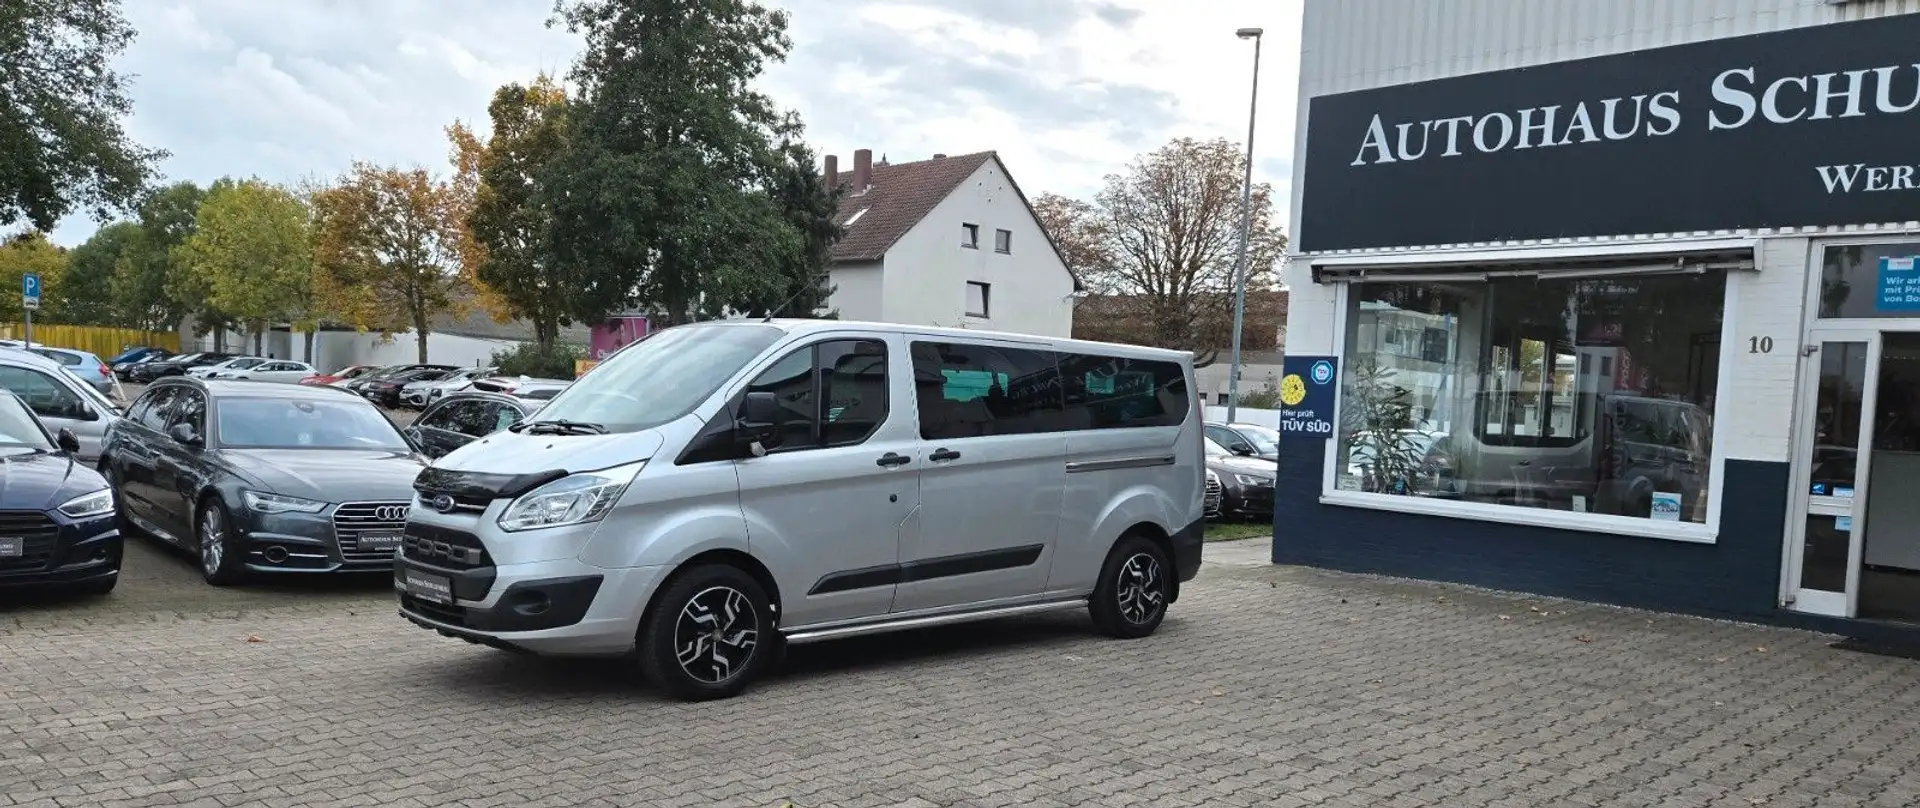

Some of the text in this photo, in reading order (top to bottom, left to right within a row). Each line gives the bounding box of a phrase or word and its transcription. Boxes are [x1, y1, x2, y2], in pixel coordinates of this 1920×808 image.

[1350, 90, 1681, 166] AUTOHAUS
[1815, 163, 1920, 194] WER
[26, 277, 35, 294] P
[1886, 276, 1904, 285] Wir
[1885, 286, 1902, 294] mit
[1749, 336, 1773, 353] 10
[1298, 409, 1314, 418] prüft
[1282, 418, 1331, 433] TÜV SÜD
